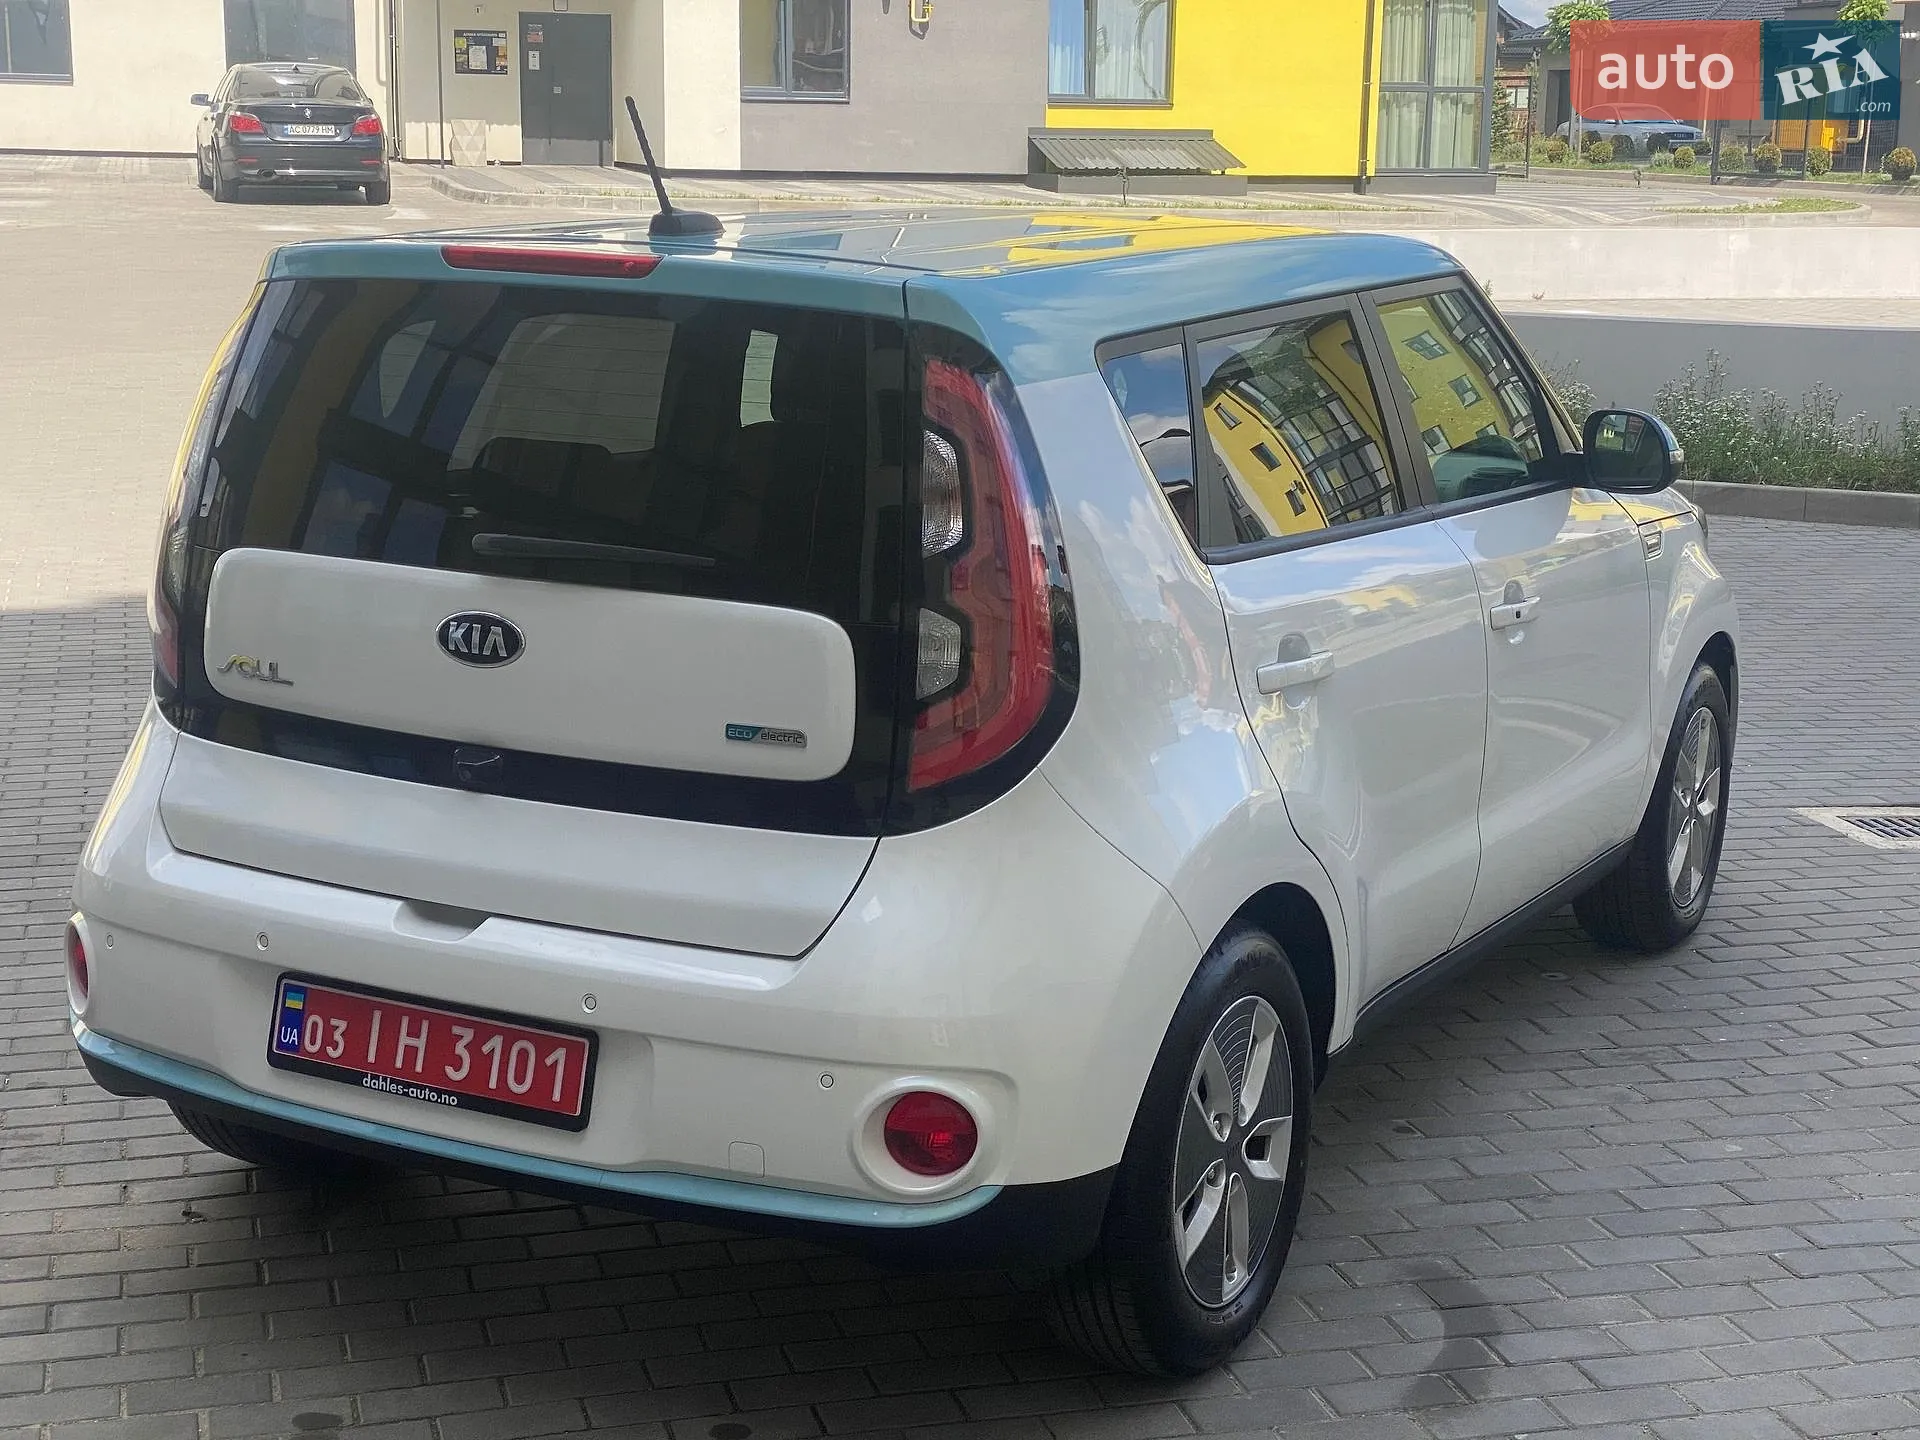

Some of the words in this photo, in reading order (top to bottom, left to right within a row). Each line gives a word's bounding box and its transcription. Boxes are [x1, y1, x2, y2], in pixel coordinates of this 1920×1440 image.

[290, 124, 301, 134] AC
[302, 124, 320, 134] 0779
[321, 125, 334, 134] HM
[447, 621, 508, 658] KIA
[727, 727, 753, 739] ECO
[760, 730, 803, 744] electric
[280, 1025, 299, 1047] UA
[303, 1014, 348, 1059] 03
[367, 1009, 430, 1074] IH
[444, 1024, 568, 1103] 3101
[362, 1074, 459, 1107] dahles-auto.no
